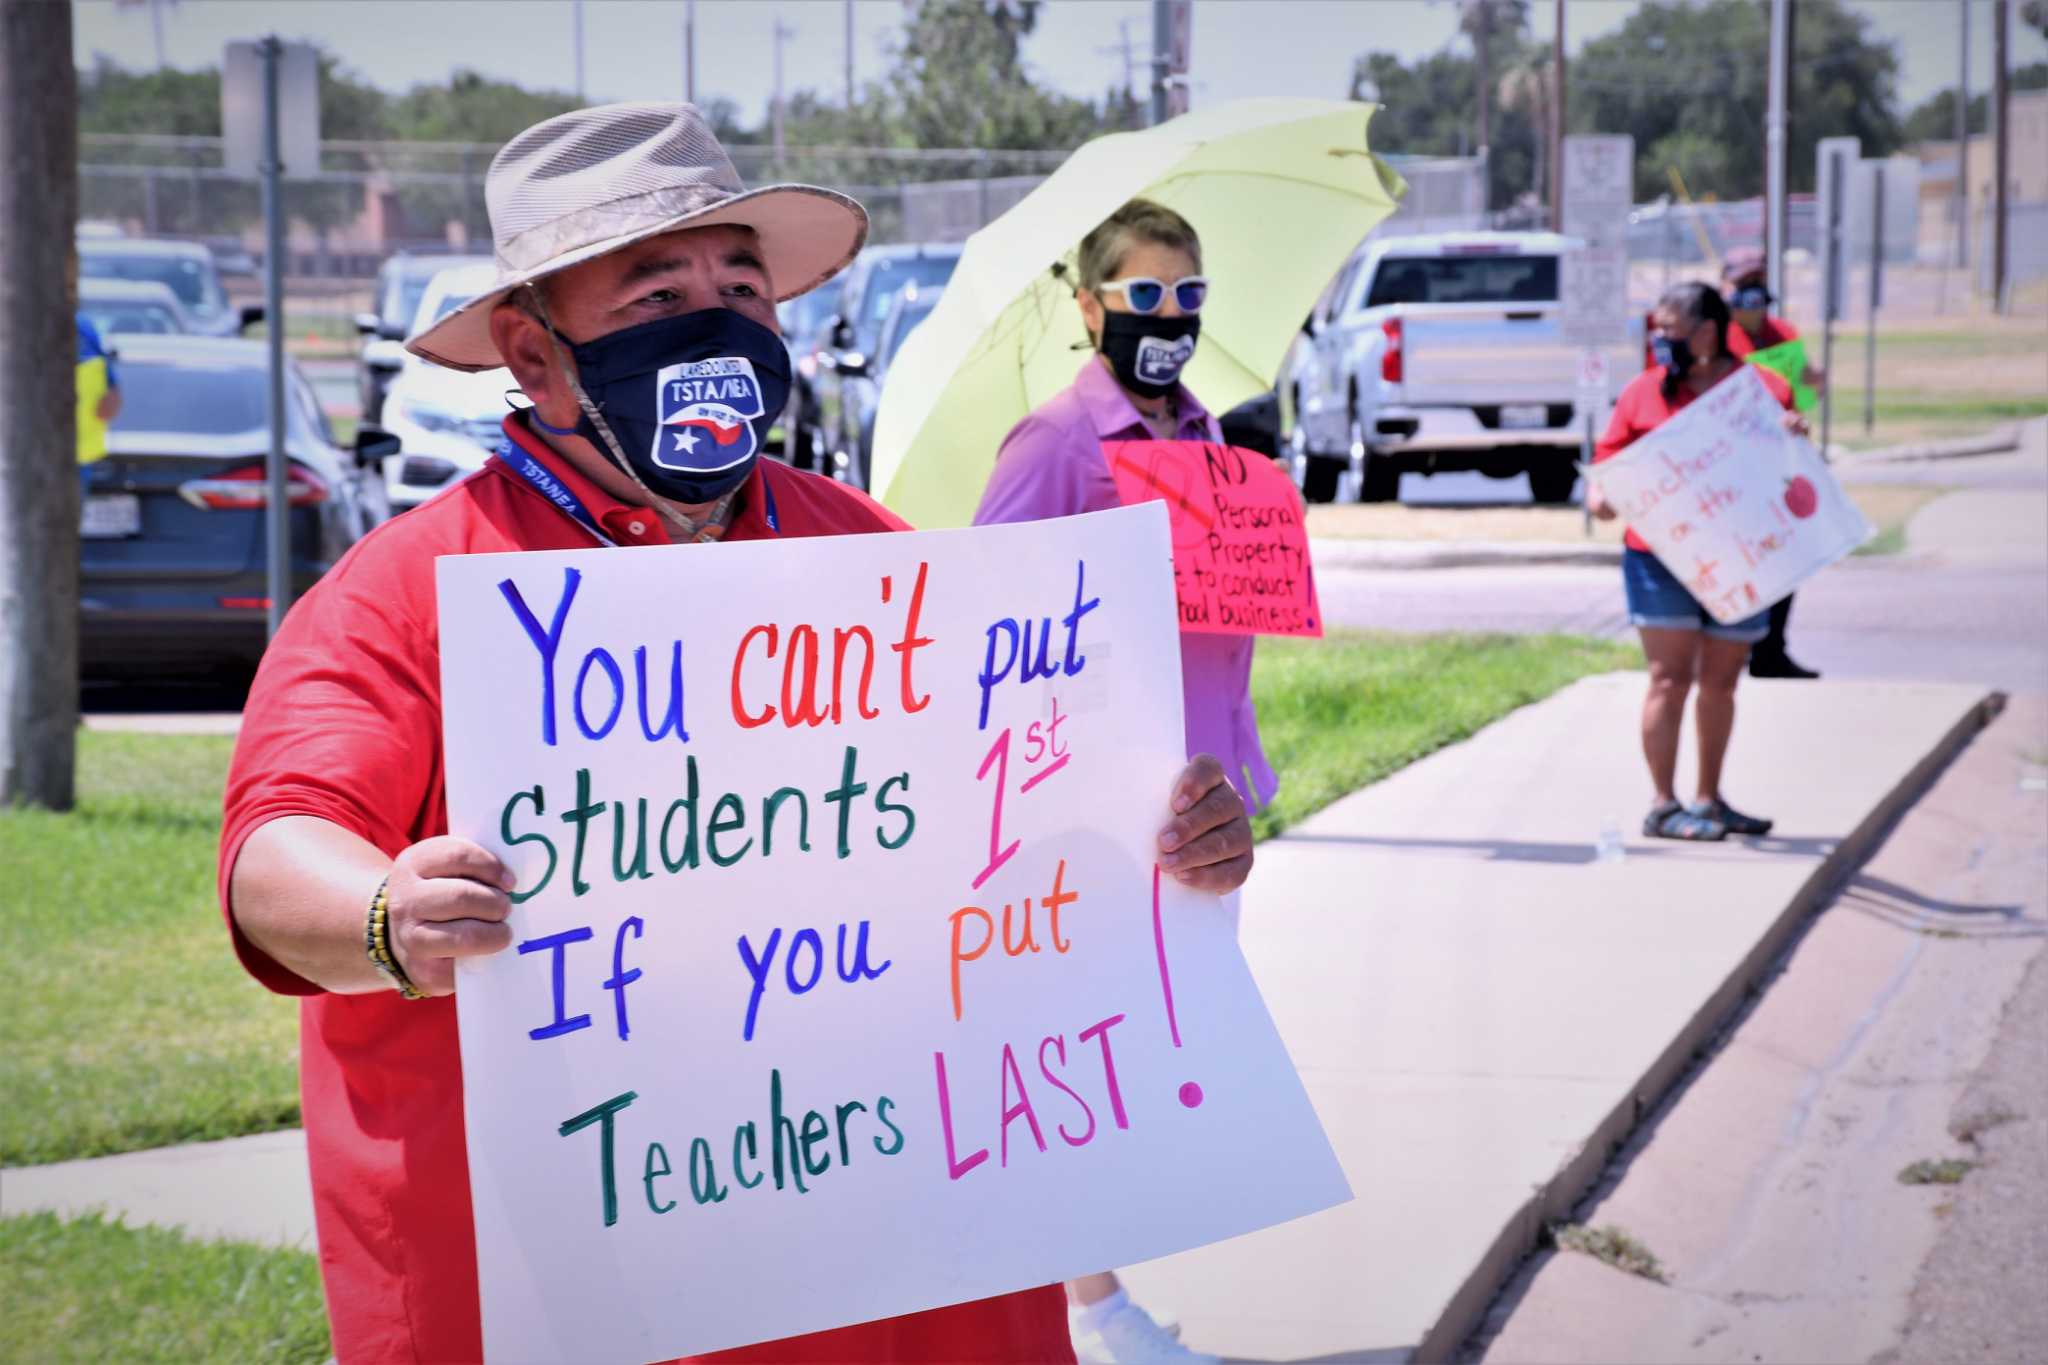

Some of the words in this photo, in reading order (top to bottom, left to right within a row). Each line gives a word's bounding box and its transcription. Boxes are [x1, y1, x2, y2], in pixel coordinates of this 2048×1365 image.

[1177, 589, 1210, 625] hool
[1193, 555, 1217, 588] to
[1221, 572, 1295, 598] conduct
[1206, 532, 1303, 575] Property
[497, 566, 691, 747] You
[730, 559, 936, 729] can't
[978, 559, 1101, 730] put
[500, 744, 917, 905] Students
[972, 696, 1072, 891] 1st
[517, 915, 645, 1042] If
[736, 919, 892, 1042] you
[947, 858, 1080, 1022] put
[558, 1068, 906, 1228] Teachers
